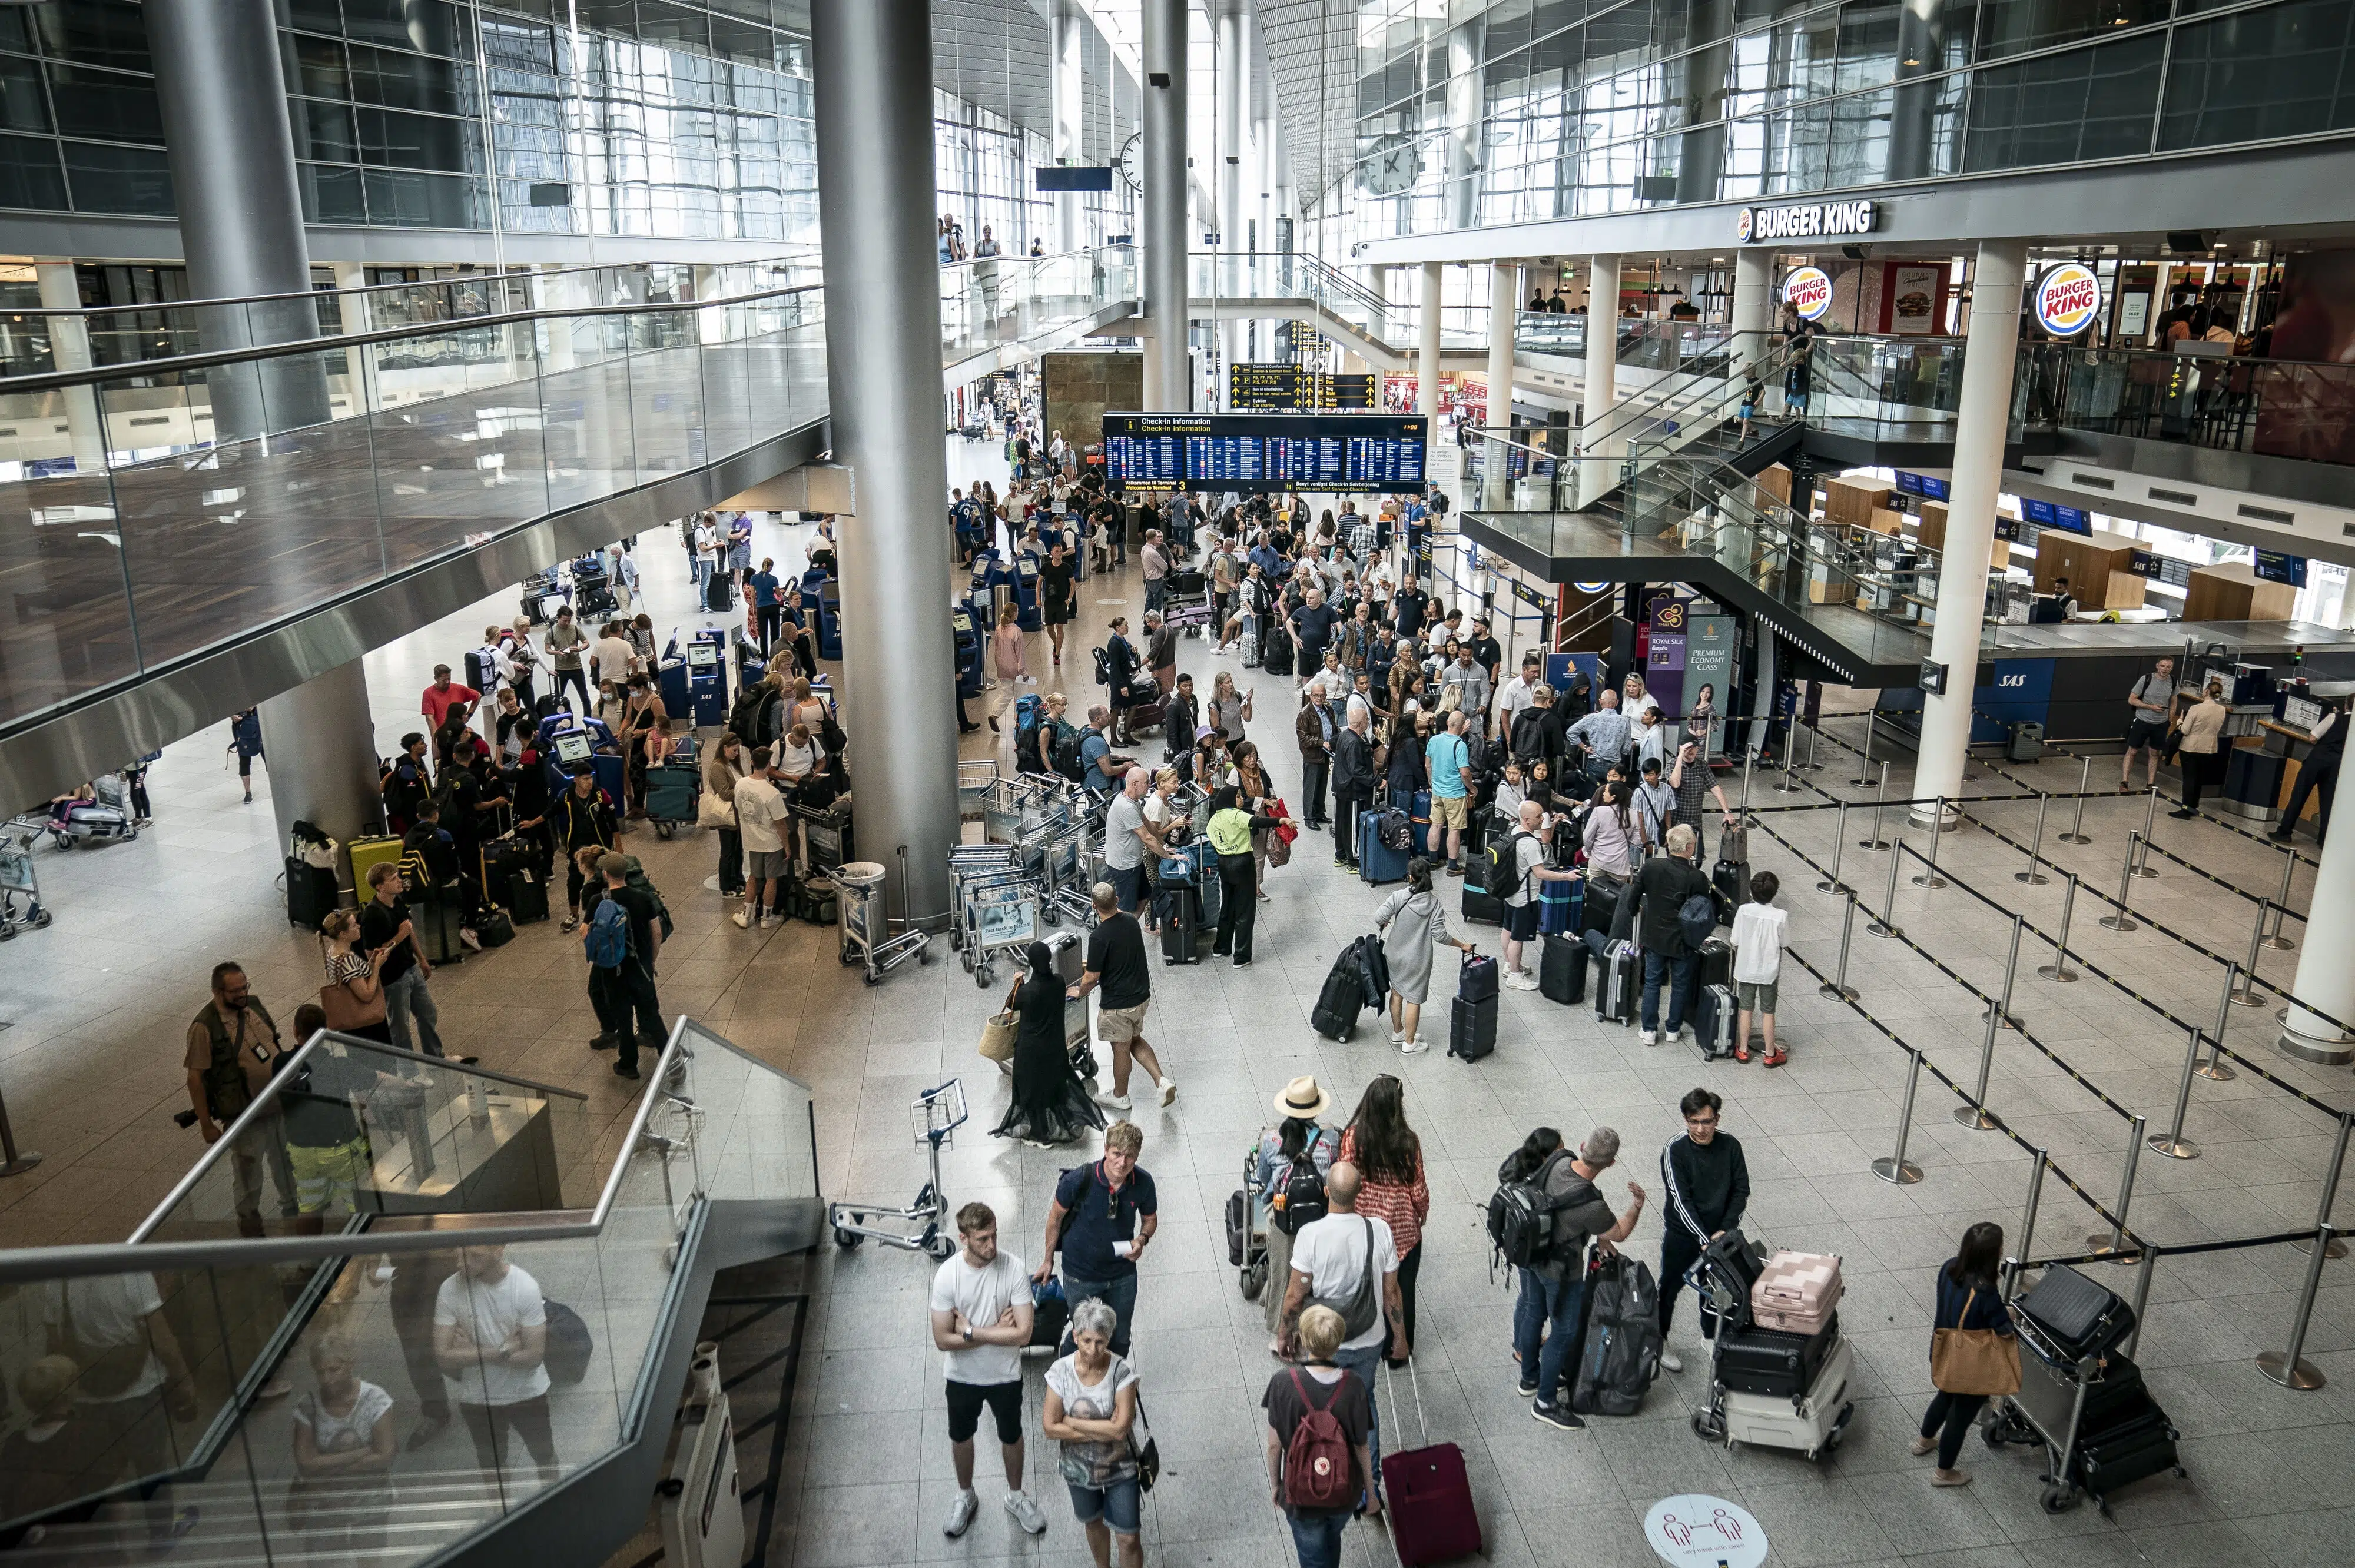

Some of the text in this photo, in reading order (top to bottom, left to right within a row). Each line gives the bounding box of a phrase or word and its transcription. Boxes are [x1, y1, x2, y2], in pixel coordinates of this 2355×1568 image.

[1756, 201, 1871, 238] BURGER KING
[1790, 278, 1825, 295] BURGER
[2046, 279, 2092, 301] BURGER
[1791, 287, 1826, 305] KING
[2045, 291, 2094, 318] KING
[1179, 481, 1185, 490] 3
[963, 507, 970, 520] 9
[2133, 562, 2146, 572] SAS
[1999, 675, 2026, 687] SAS
